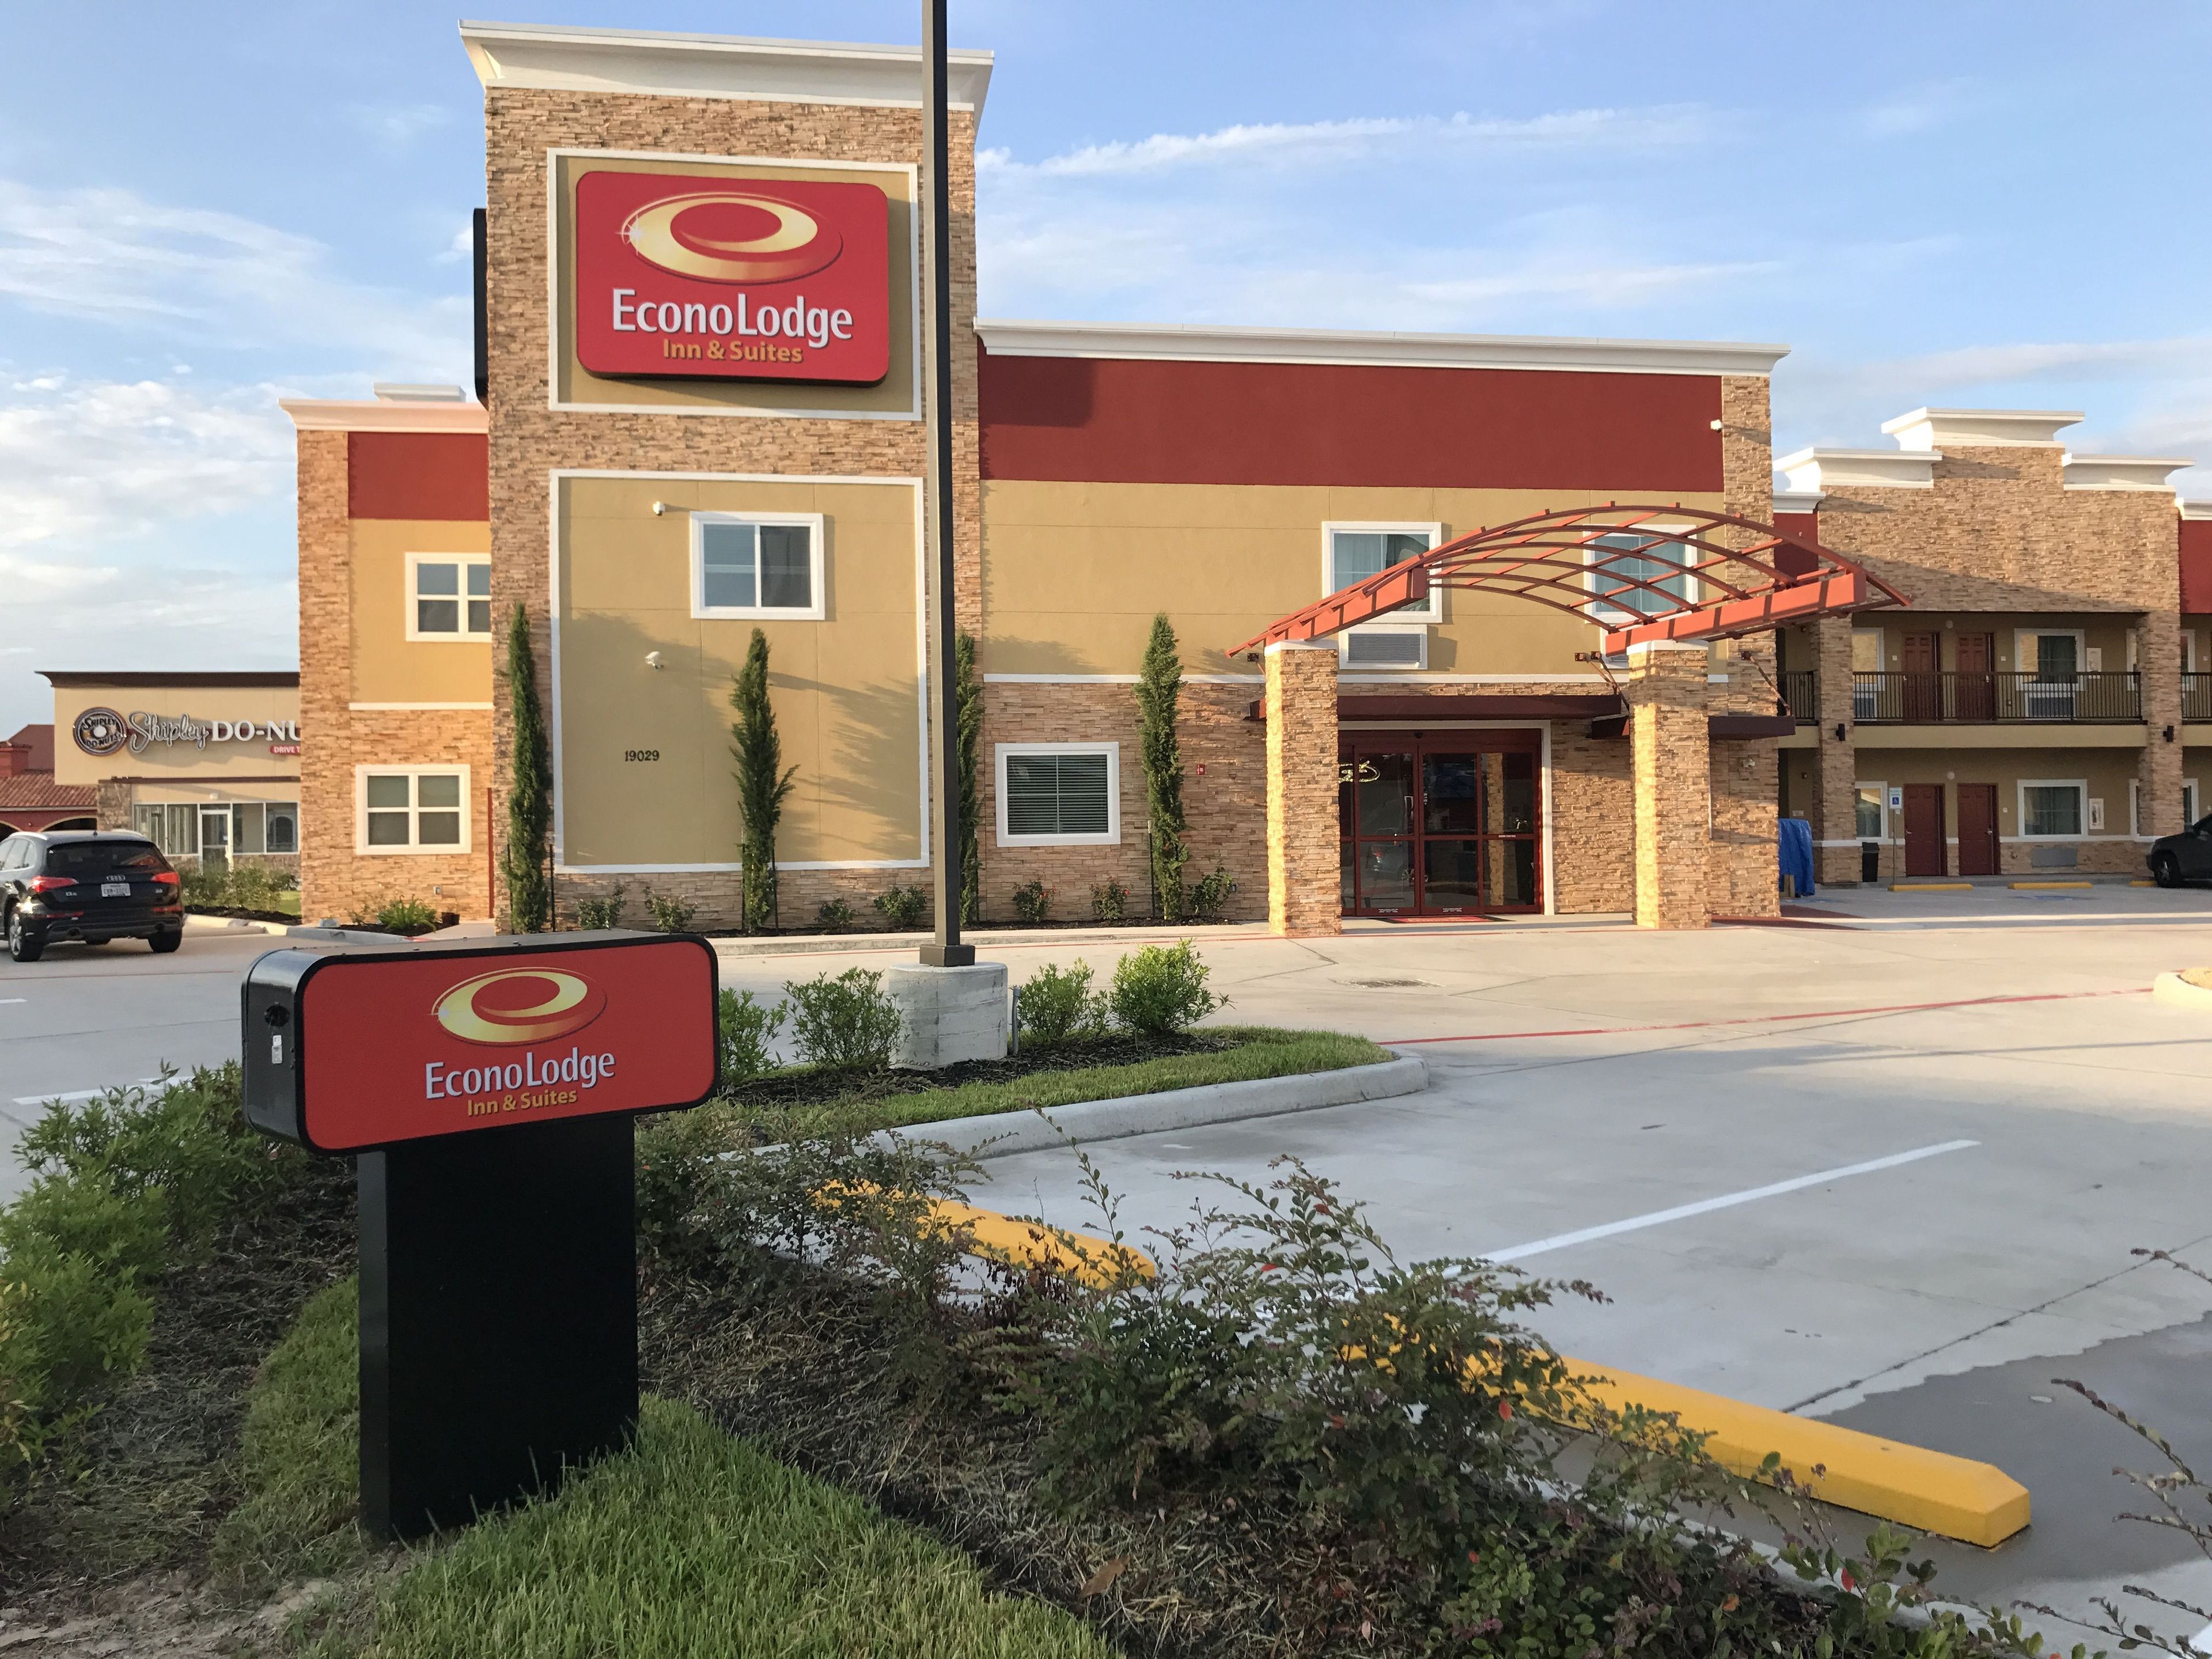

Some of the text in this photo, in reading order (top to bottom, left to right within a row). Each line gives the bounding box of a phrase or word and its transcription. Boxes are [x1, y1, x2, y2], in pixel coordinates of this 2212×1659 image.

[612, 288, 853, 348] EconoLodge
[664, 339, 803, 362] Inn & Suites
[129, 711, 209, 753] Shipley
[624, 750, 660, 762] 19029
[425, 1047, 615, 1099] EconoLodge
[467, 1088, 577, 1116] Inn & Suites
